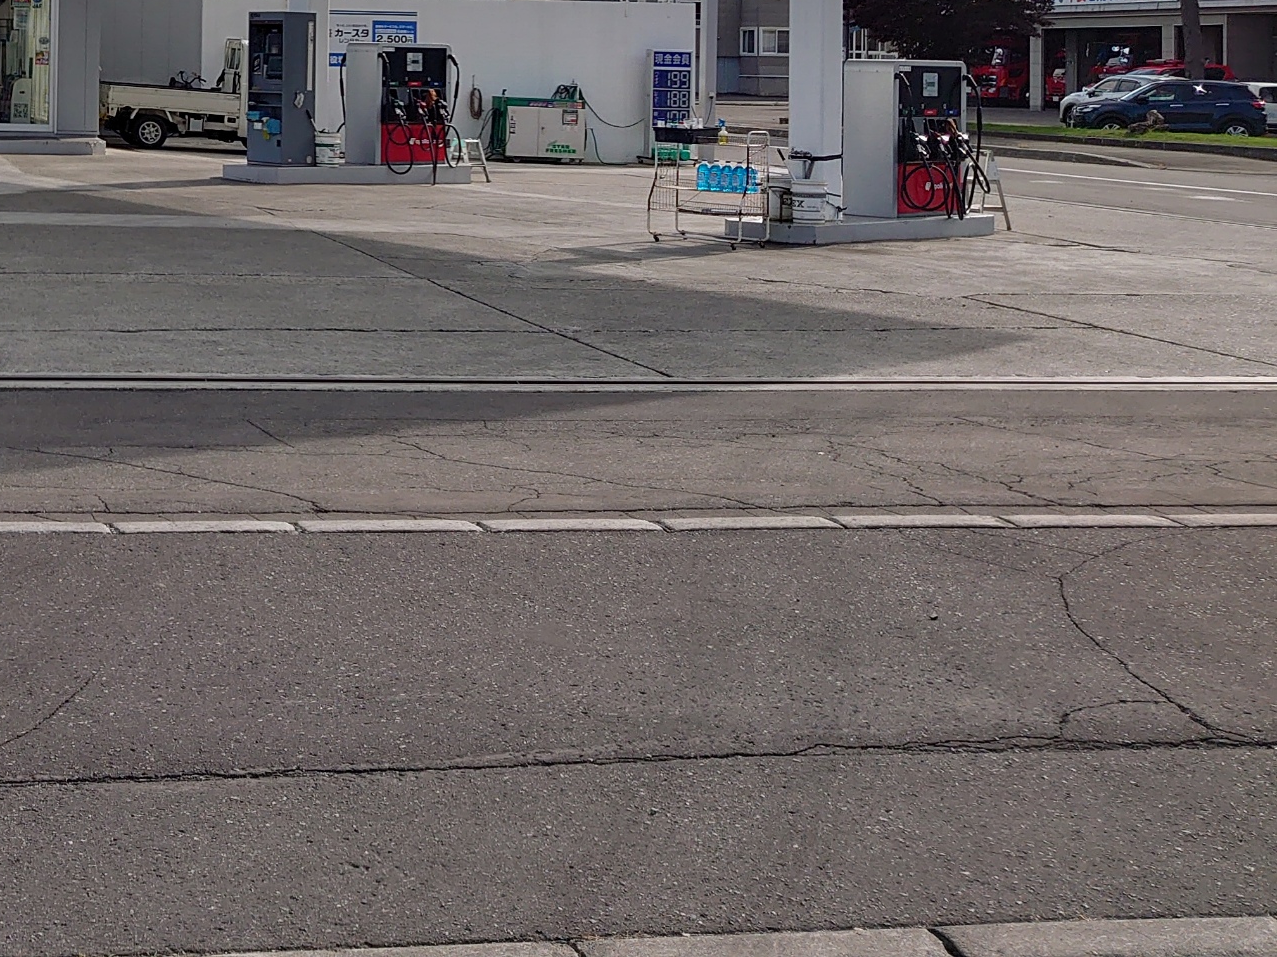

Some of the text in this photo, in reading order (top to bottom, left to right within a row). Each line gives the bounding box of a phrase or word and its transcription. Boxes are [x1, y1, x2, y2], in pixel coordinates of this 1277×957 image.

[335, 29, 369, 38] カースタ
[655, 53, 690, 65] 現金会員
[667, 71, 689, 88] 199
[667, 91, 689, 107] 188
